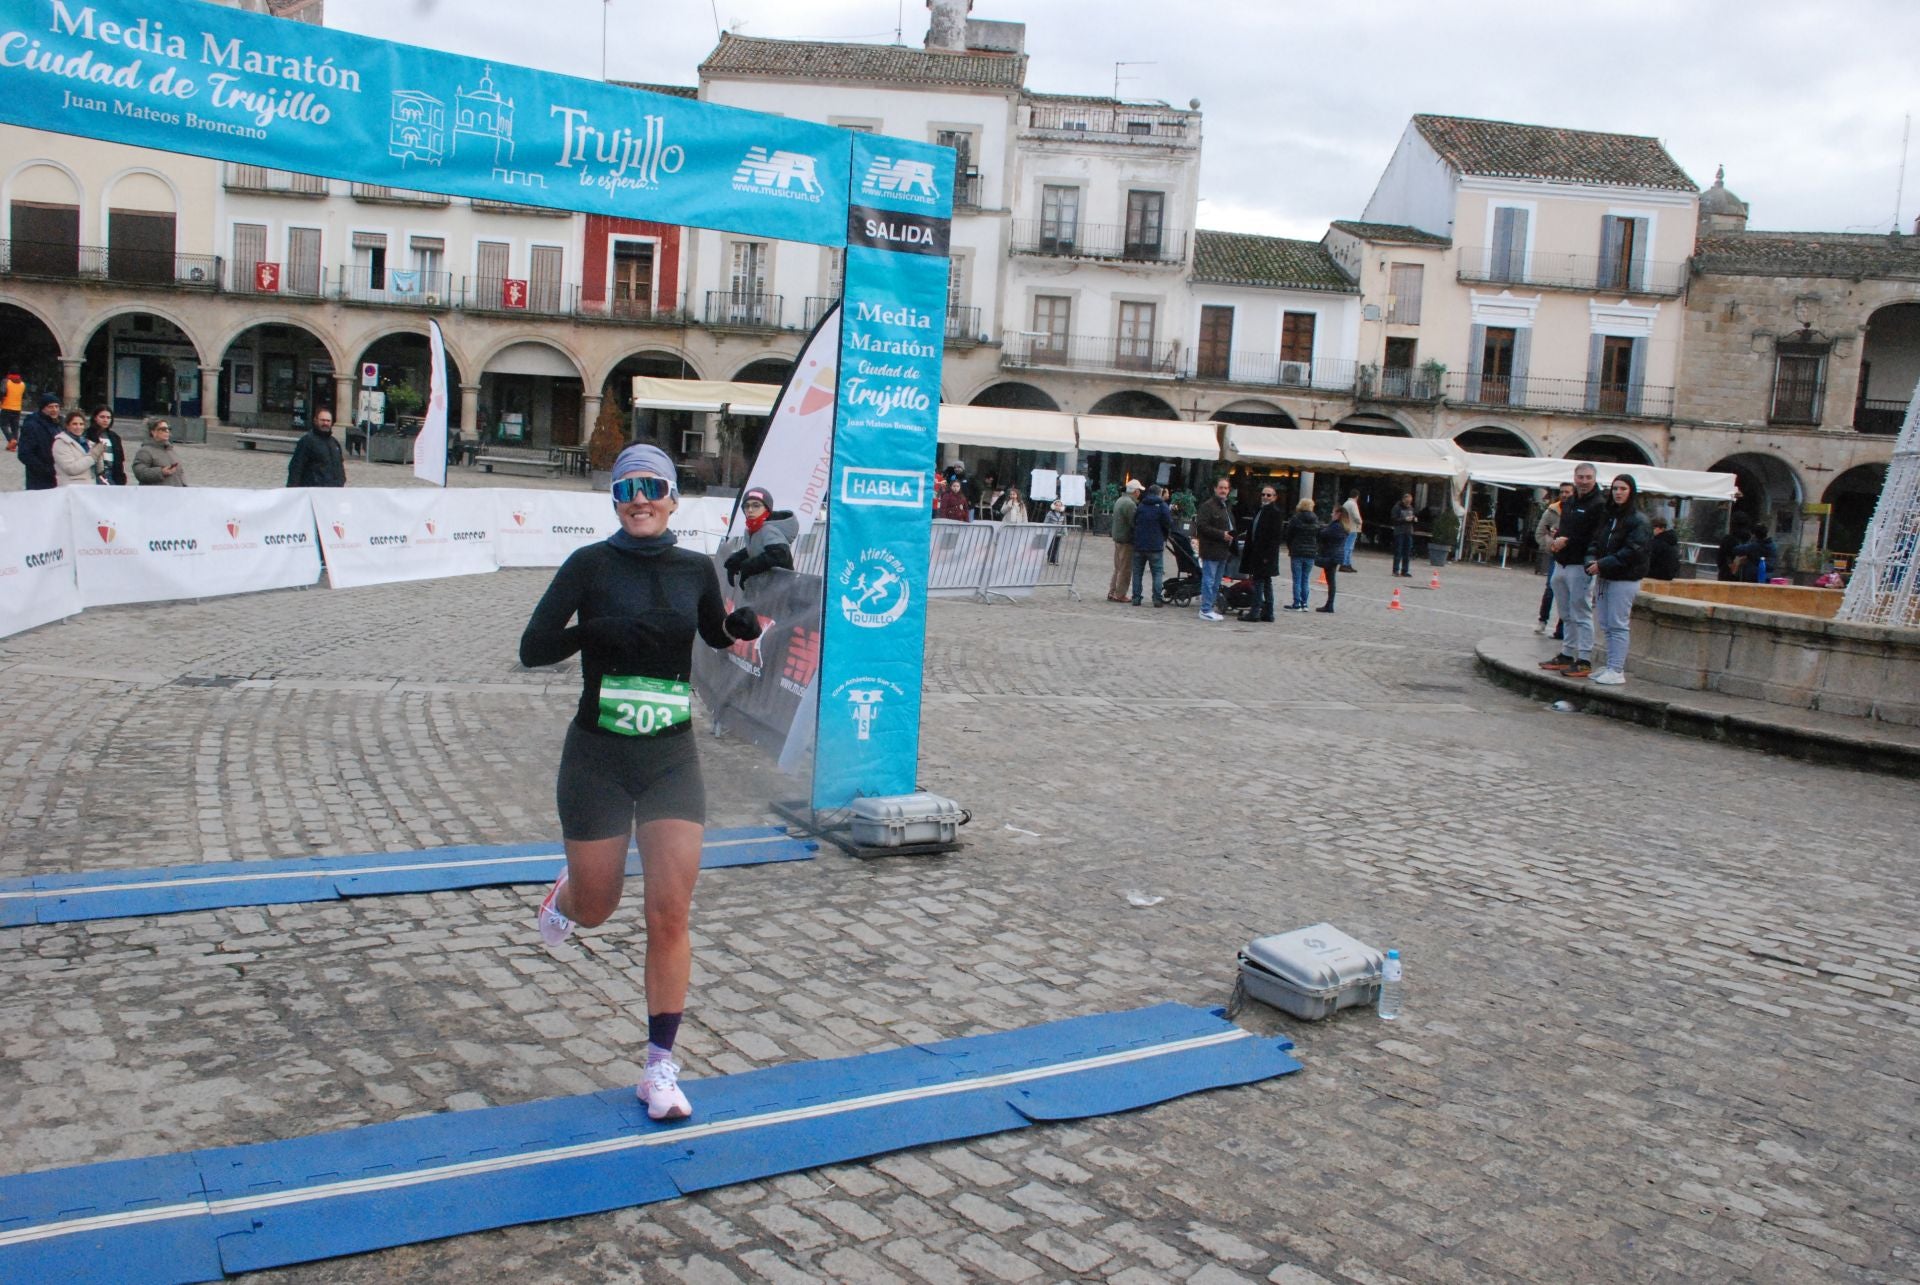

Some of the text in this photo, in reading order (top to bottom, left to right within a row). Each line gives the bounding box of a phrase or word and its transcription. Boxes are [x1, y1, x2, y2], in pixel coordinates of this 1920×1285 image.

[50, 0, 361, 93] Media Maratón
[0, 31, 331, 127] Ciudad de Trujillo
[62, 90, 267, 140] Juan Mateos Broncano
[551, 104, 685, 184] Trujillo
[579, 164, 596, 186] te
[732, 182, 821, 204] www.musicrun.es
[861, 186, 936, 205] www.musicrun.es
[865, 219, 934, 245] SALIDA
[856, 302, 931, 329] Media
[850, 332, 936, 358] Maratón
[858, 359, 921, 379] Ciudad de
[846, 377, 930, 417] Trujillo
[866, 419, 893, 430] Mateos
[853, 479, 912, 497] HABLA
[839, 559, 856, 585] Club
[614, 703, 673, 733] 203
[861, 719, 868, 732] S
